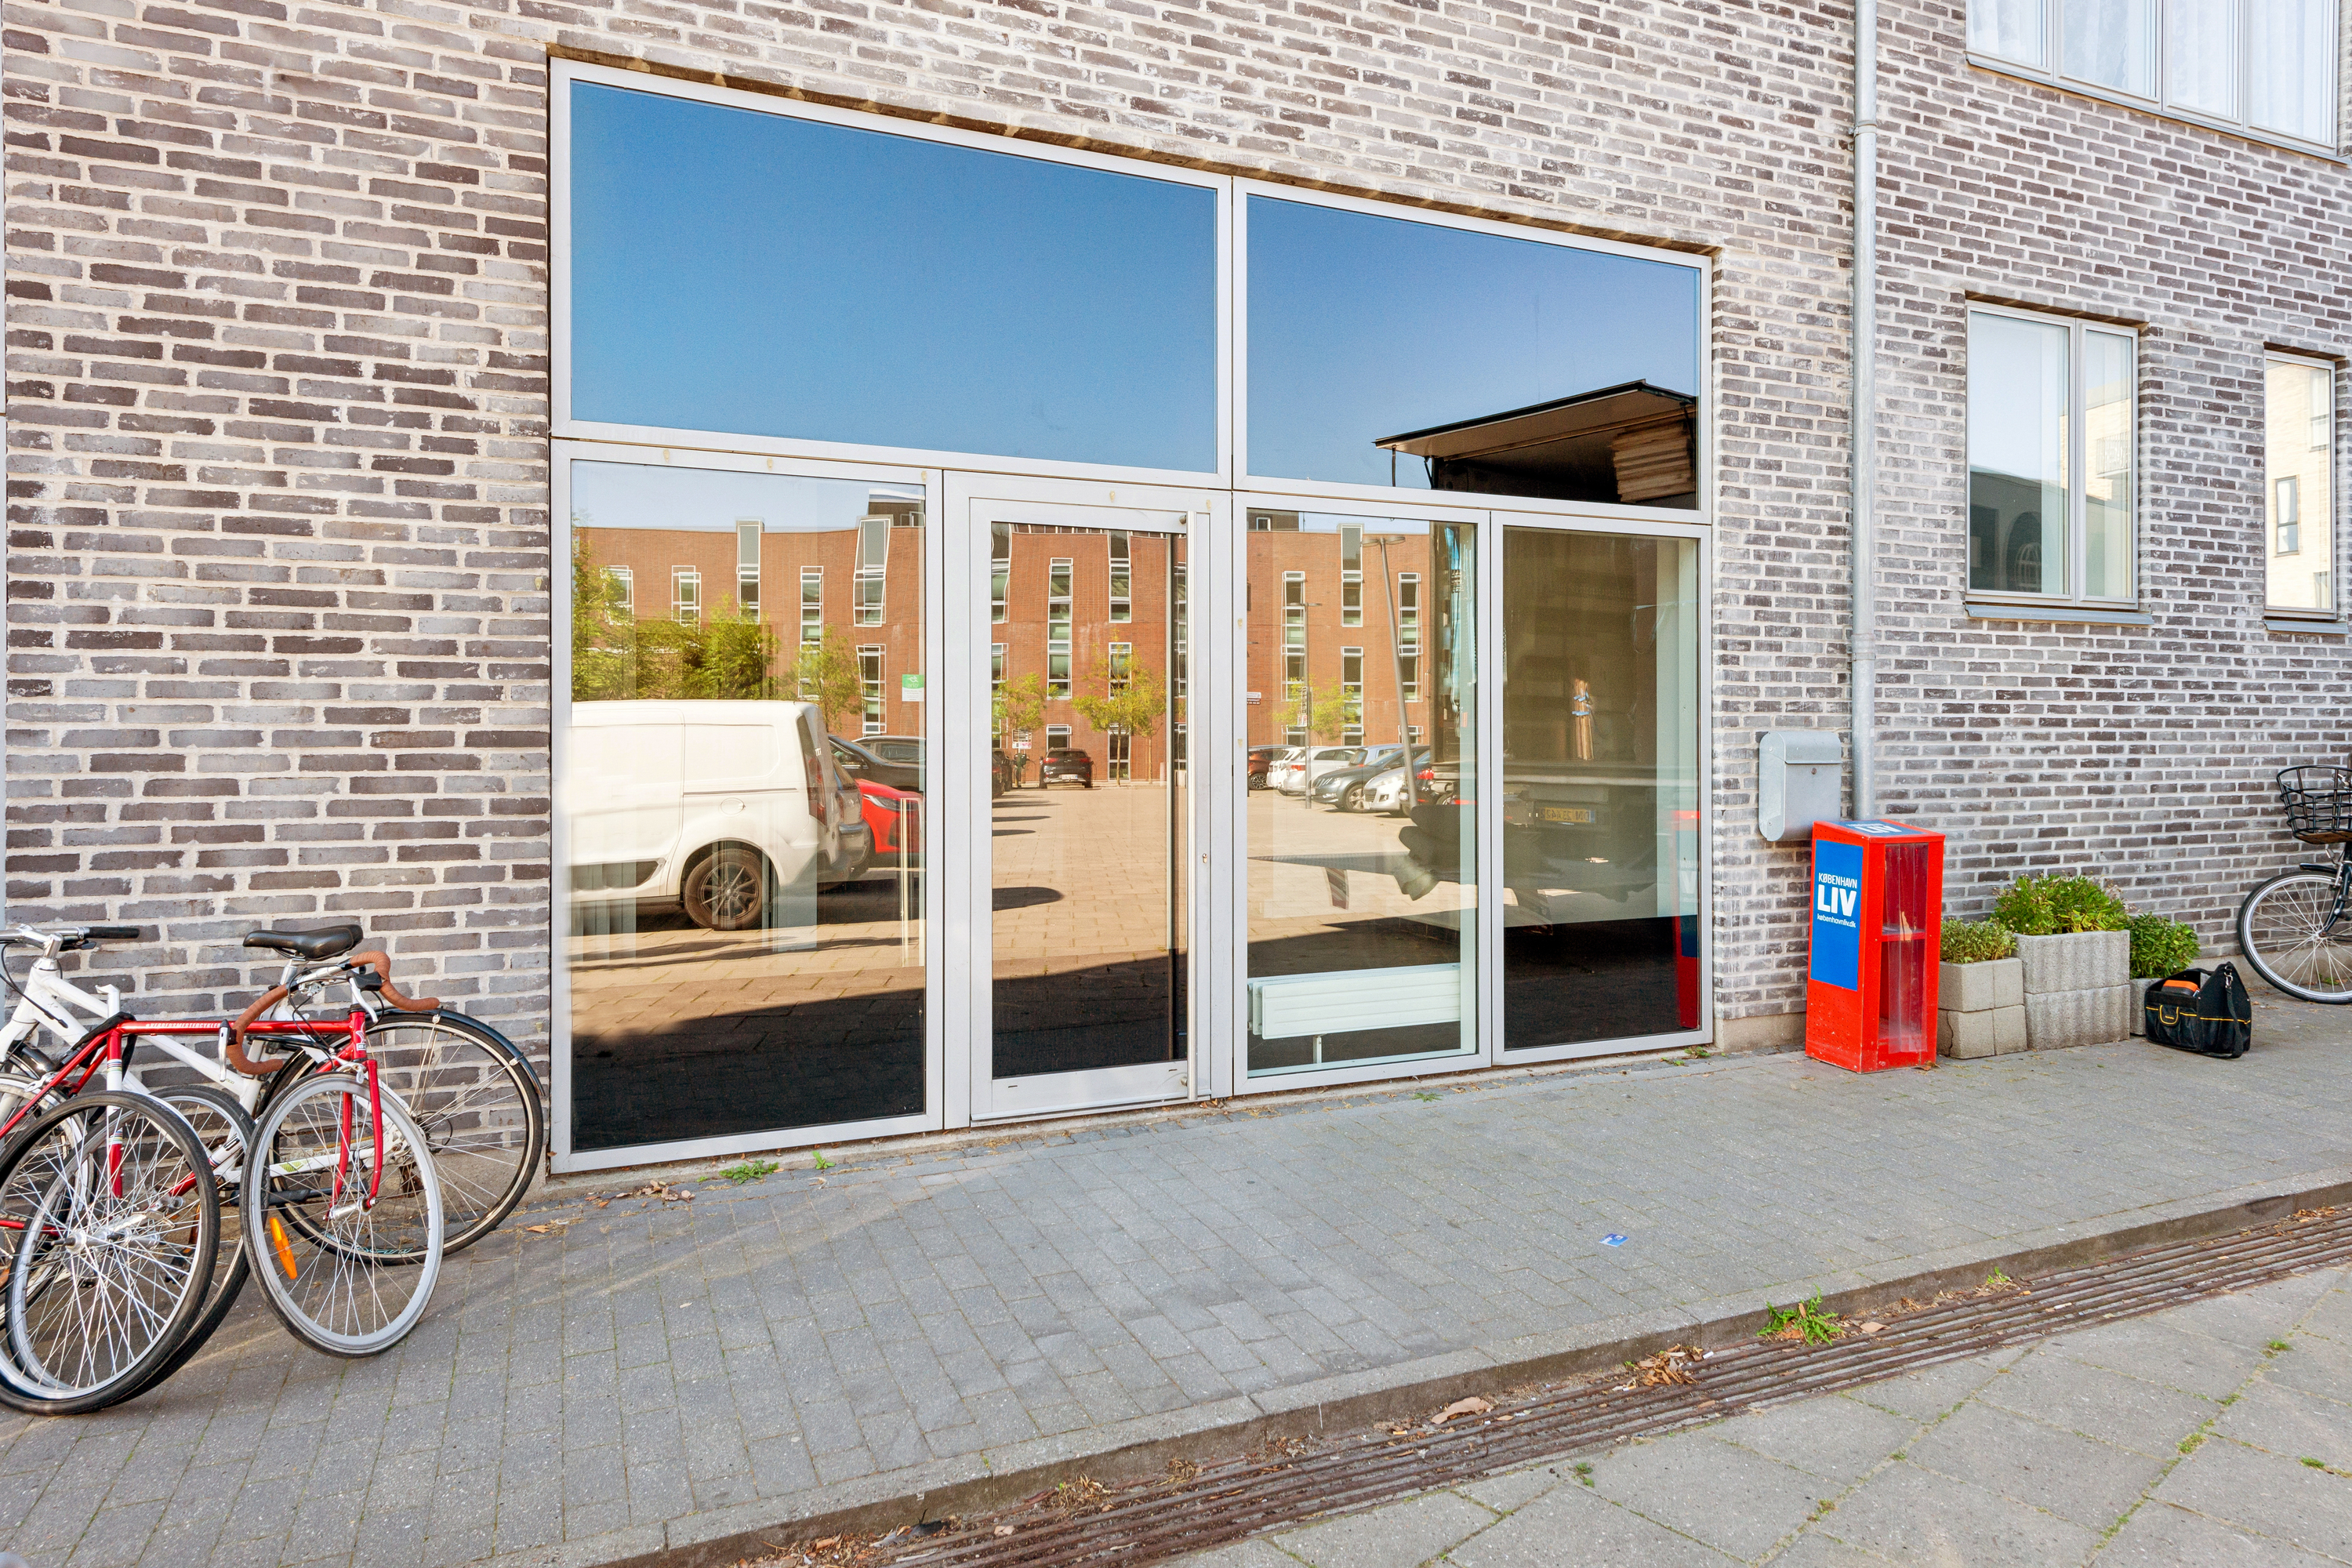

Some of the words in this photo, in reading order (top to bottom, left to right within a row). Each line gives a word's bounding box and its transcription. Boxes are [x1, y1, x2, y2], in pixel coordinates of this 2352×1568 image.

[1819, 873, 1857, 889] KØBENHAVN
[1817, 884, 1857, 917] LIV
[1817, 913, 1857, 927] københavnliv.dk
